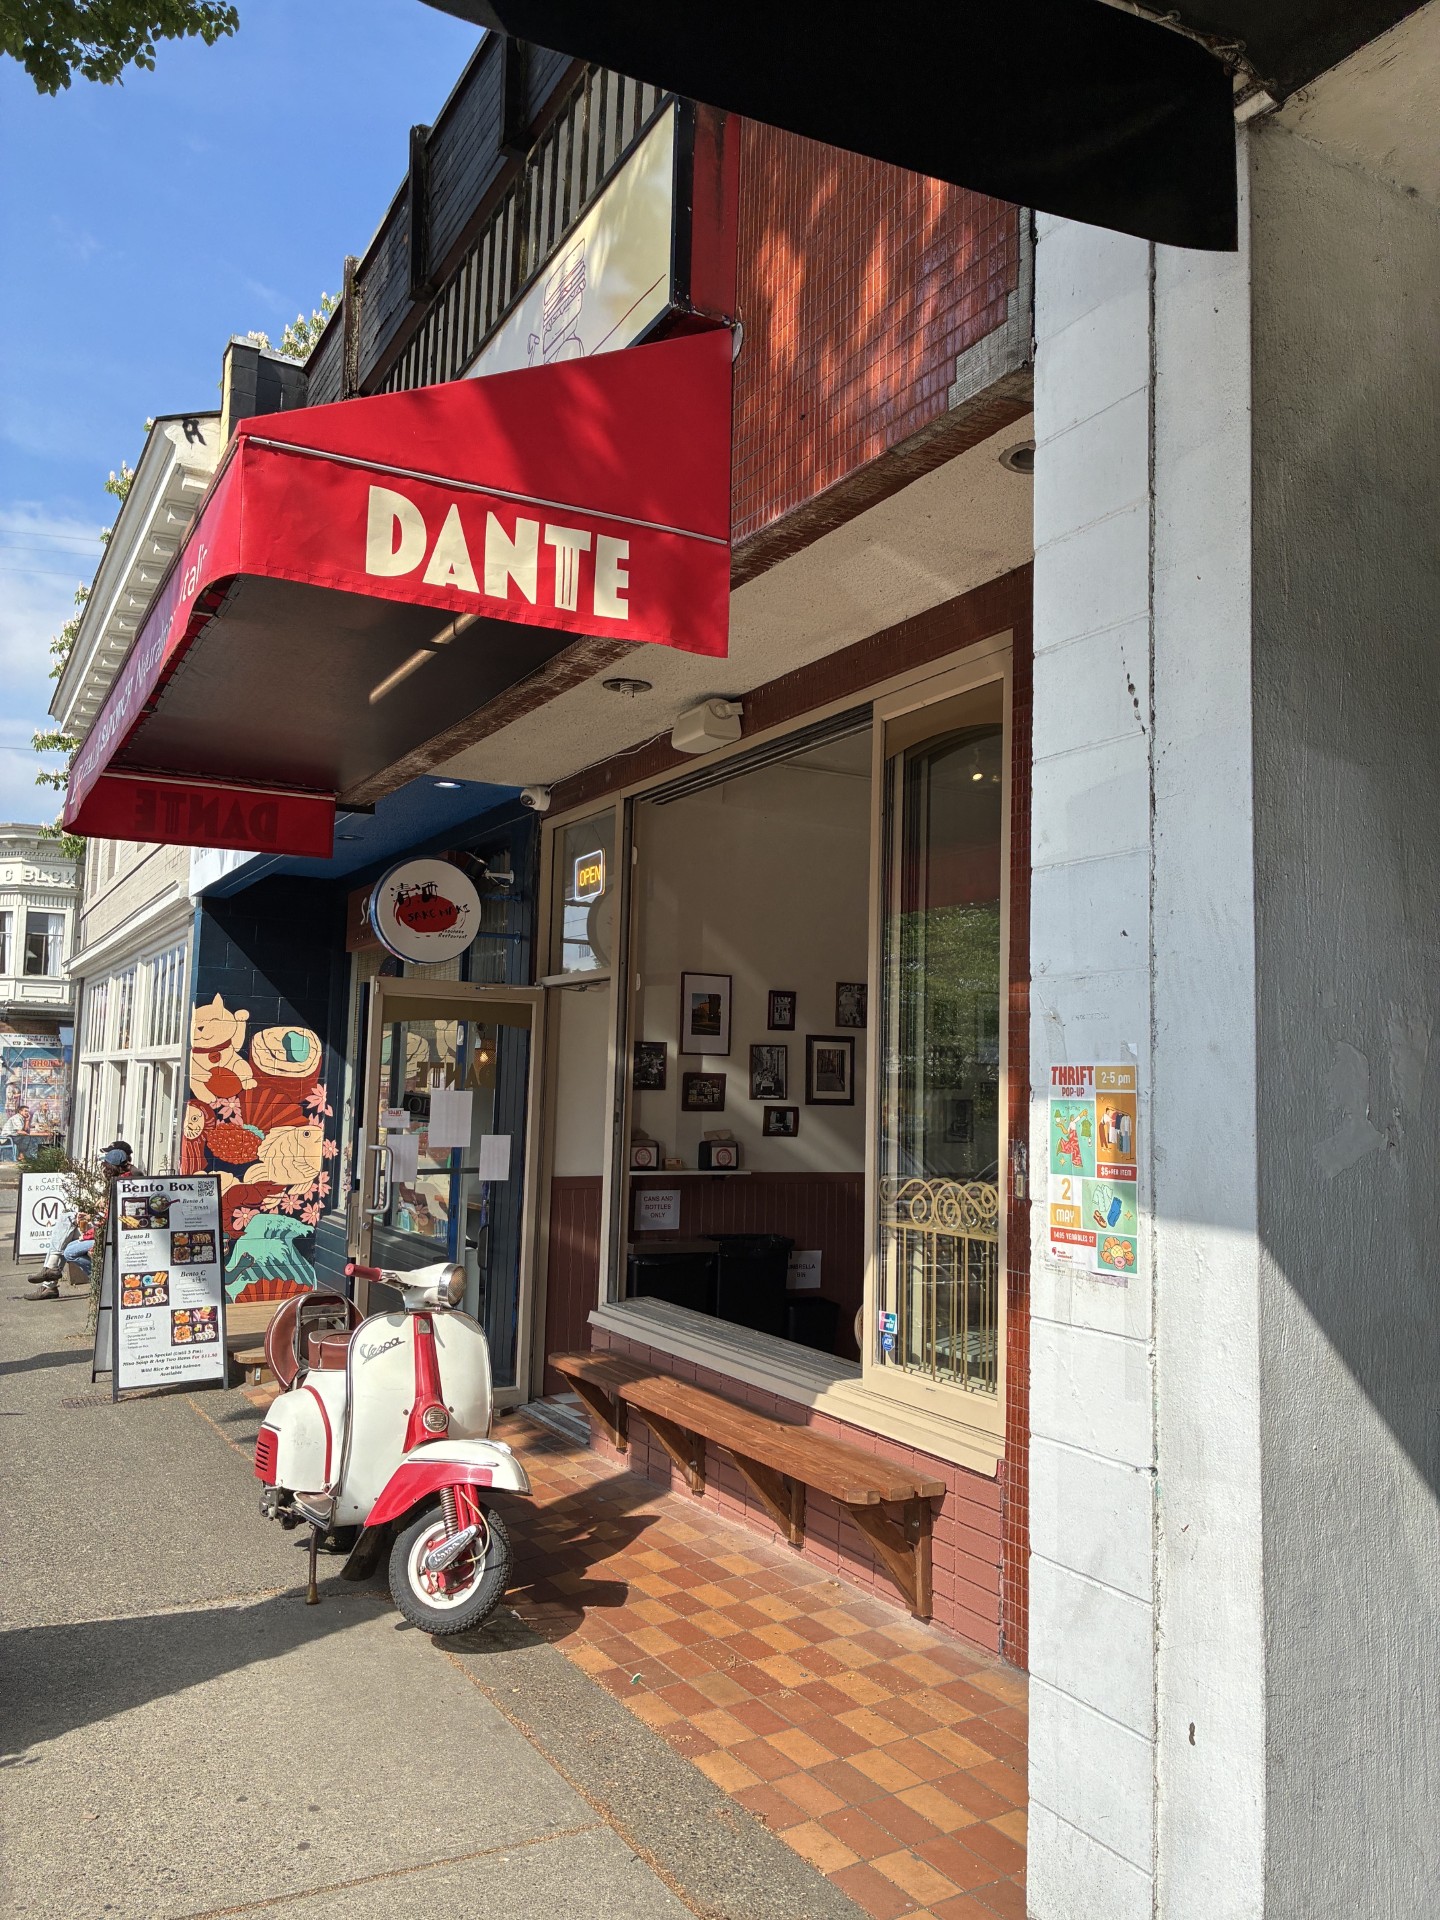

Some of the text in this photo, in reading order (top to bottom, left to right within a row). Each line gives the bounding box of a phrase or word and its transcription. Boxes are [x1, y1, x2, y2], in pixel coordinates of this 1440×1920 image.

[365, 485, 630, 620] DANTE
[579, 864, 601, 886] OPEN
[1051, 1066, 1094, 1085] THRIFT
[1101, 1072, 1131, 1086] 2-5 pm
[1062, 1087, 1085, 1097] POP-UP
[122, 1182, 194, 1193] Bento Box
[1061, 1178, 1071, 1200] 2
[41, 1203, 58, 1220] M
[1056, 1209, 1074, 1223] MAY
[360, 1337, 406, 1365] Vespa
